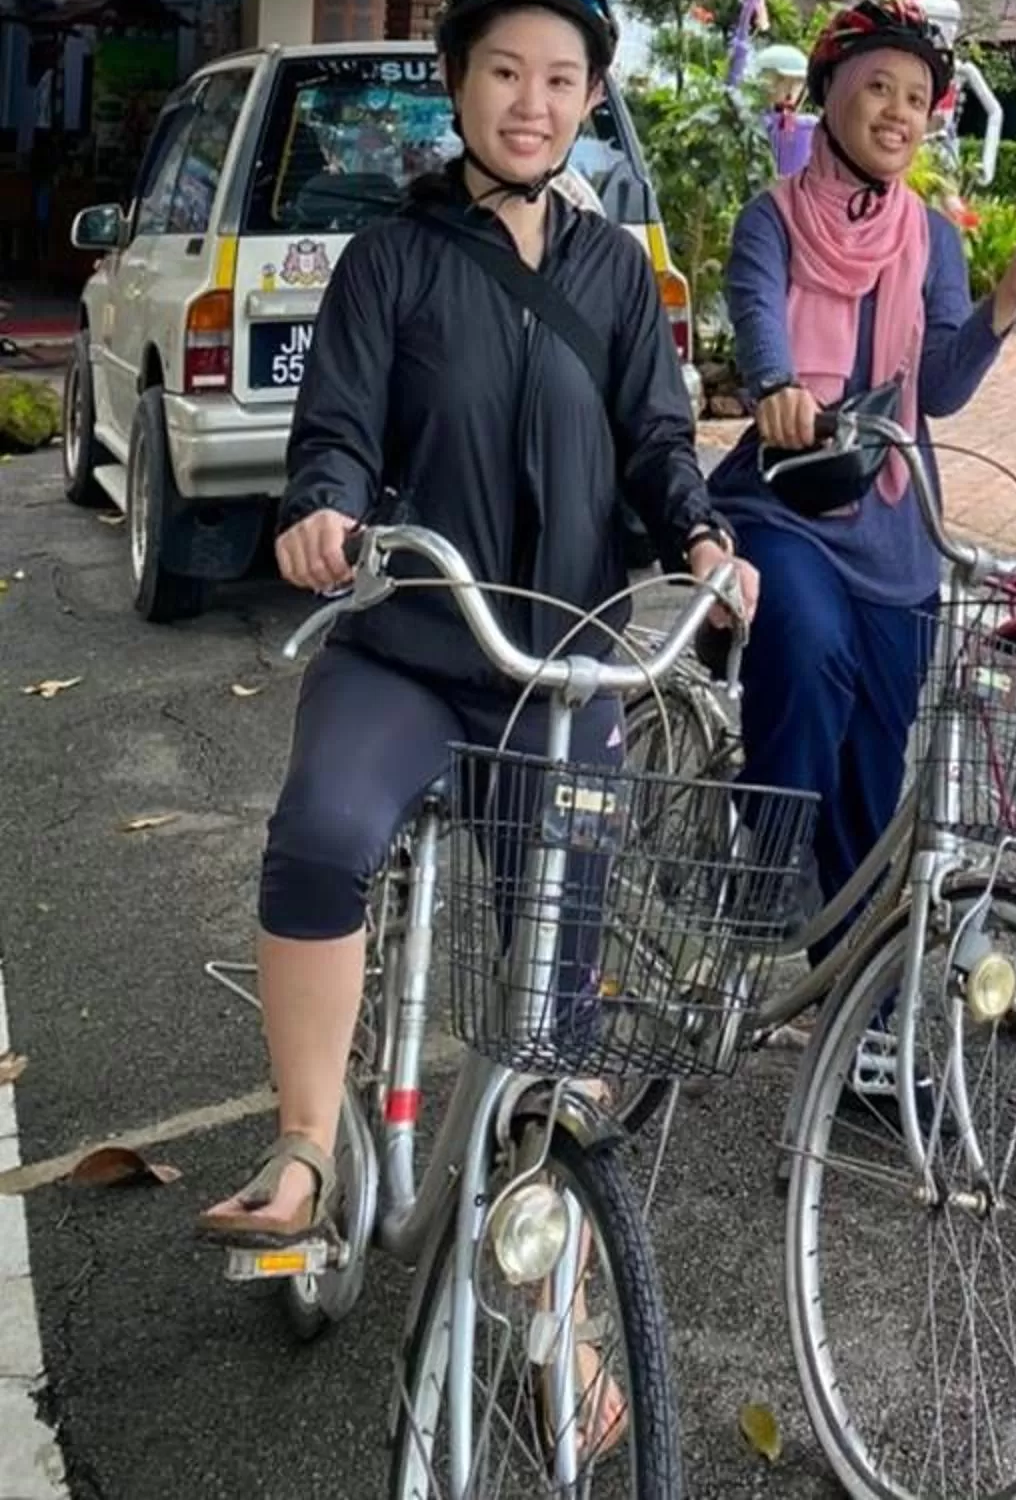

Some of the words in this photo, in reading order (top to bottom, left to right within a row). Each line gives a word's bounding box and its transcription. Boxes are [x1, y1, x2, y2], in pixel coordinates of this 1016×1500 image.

[380, 60, 442, 82] SUZ
[280, 324, 314, 354] JN
[272, 353, 305, 384] 55
